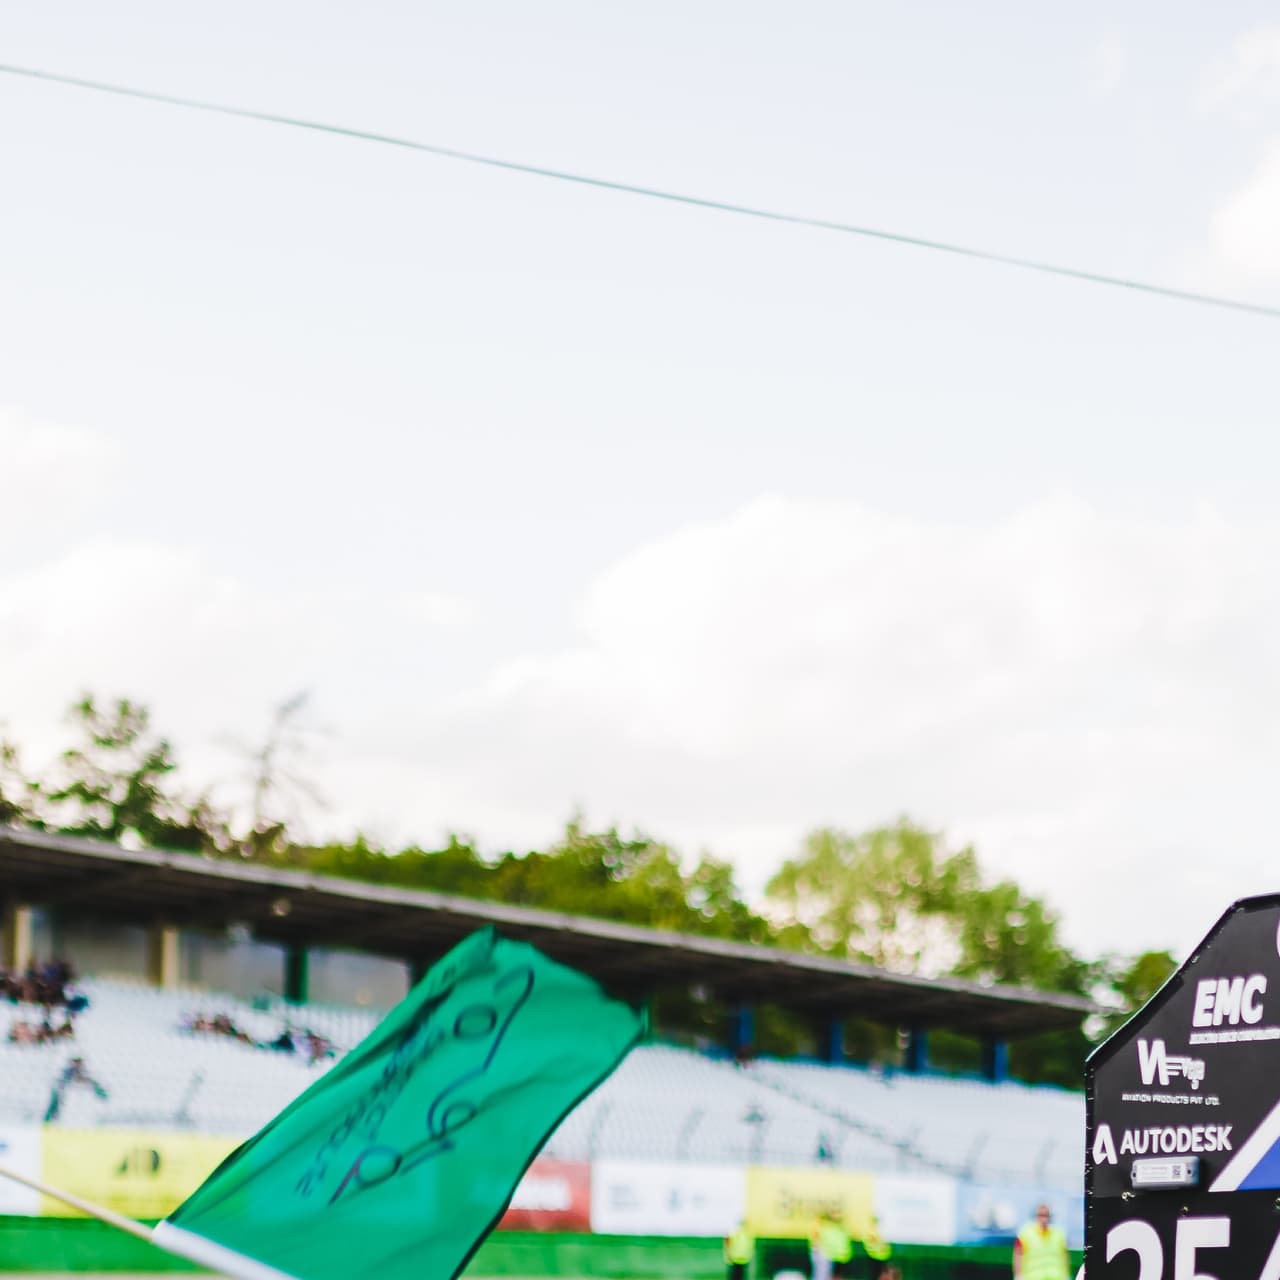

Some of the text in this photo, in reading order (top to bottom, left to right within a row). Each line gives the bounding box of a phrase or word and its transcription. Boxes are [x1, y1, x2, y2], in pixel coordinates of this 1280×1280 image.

[1192, 974, 1267, 1027] EMC
[1152, 1094, 1189, 1105] PRODUCTS
[1120, 1126, 1233, 1155] AUTODESK
